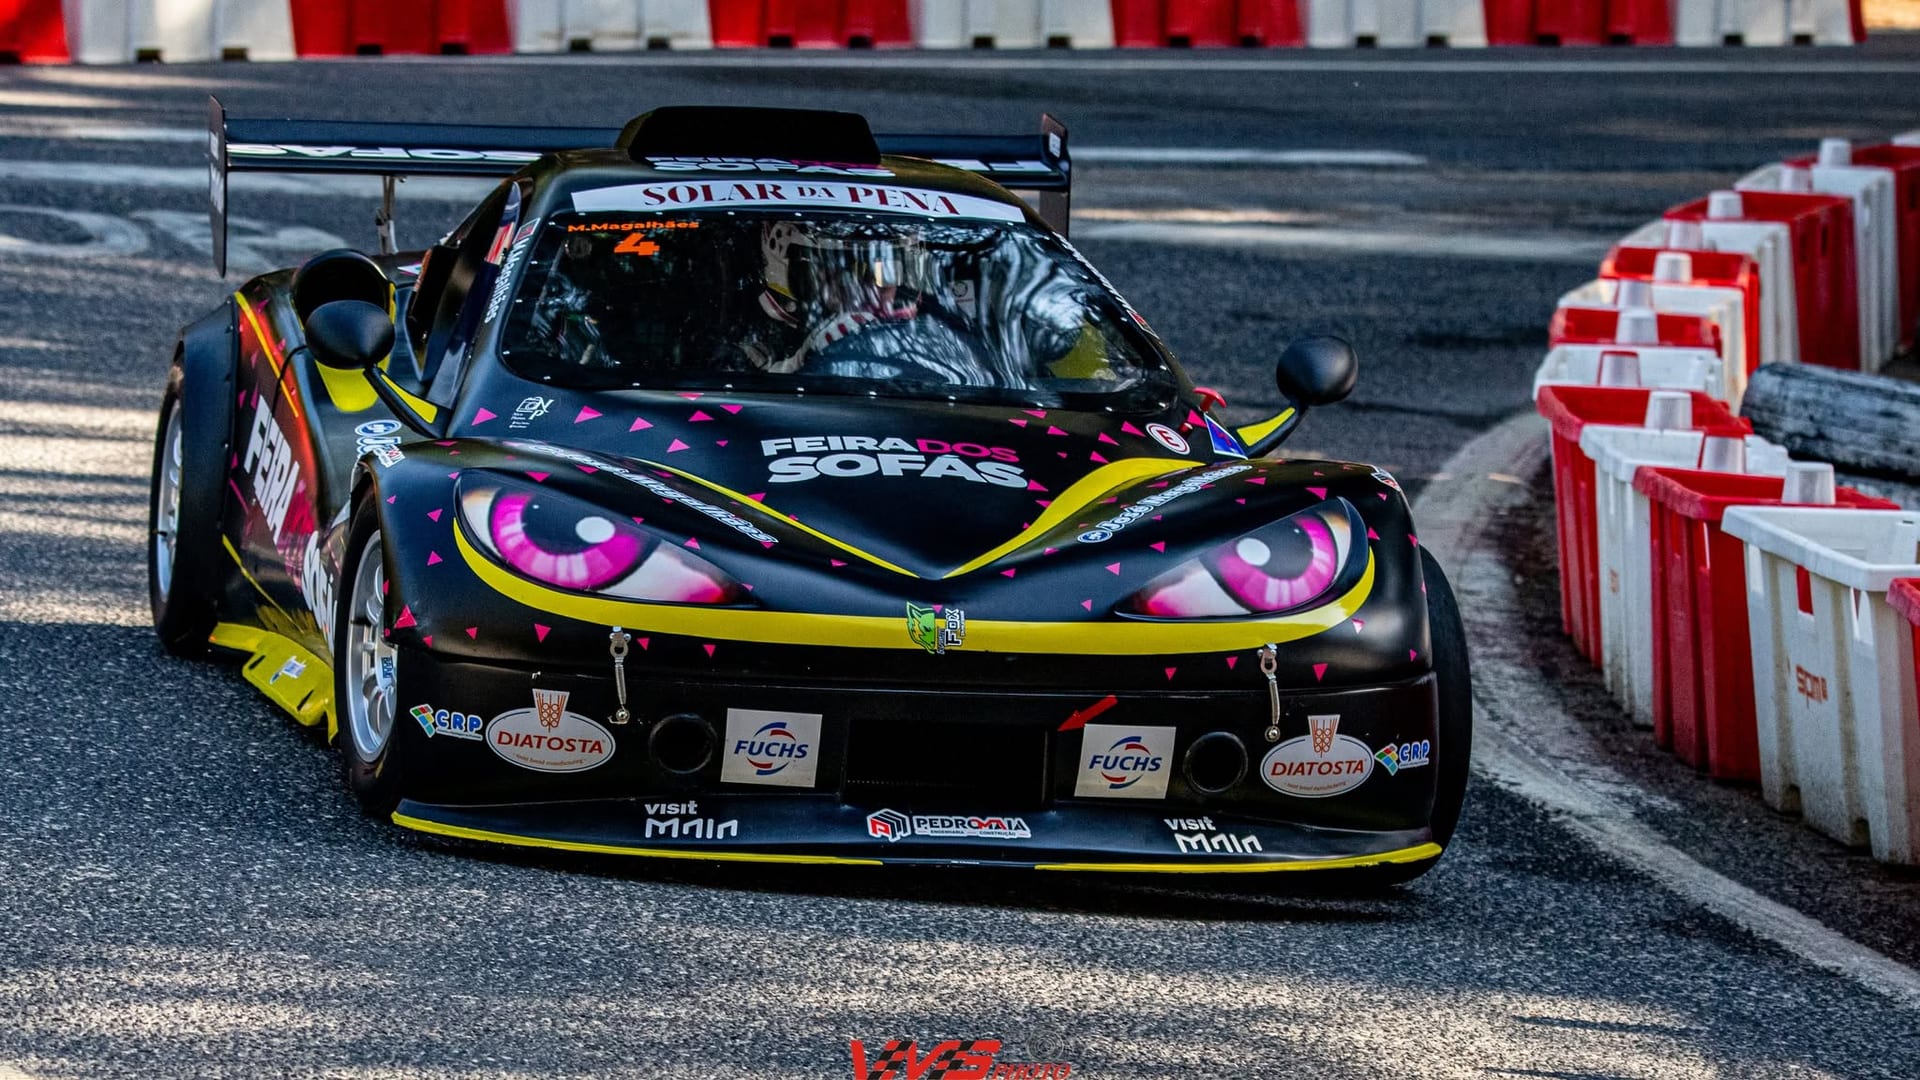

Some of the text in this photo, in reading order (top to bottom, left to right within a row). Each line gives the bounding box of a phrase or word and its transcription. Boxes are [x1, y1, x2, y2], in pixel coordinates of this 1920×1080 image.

[642, 183, 961, 215] SOLAR DA PENA
[613, 232, 661, 256] 4
[244, 394, 300, 547] FEIRA
[435, 709, 483, 732] CRP
[496, 731, 604, 754] DIATOSTA
[734, 740, 809, 759] FUCHS
[1400, 739, 1430, 762] CRP
[1088, 755, 1163, 771] FUCHS
[1270, 760, 1365, 776] DIATOSTA
